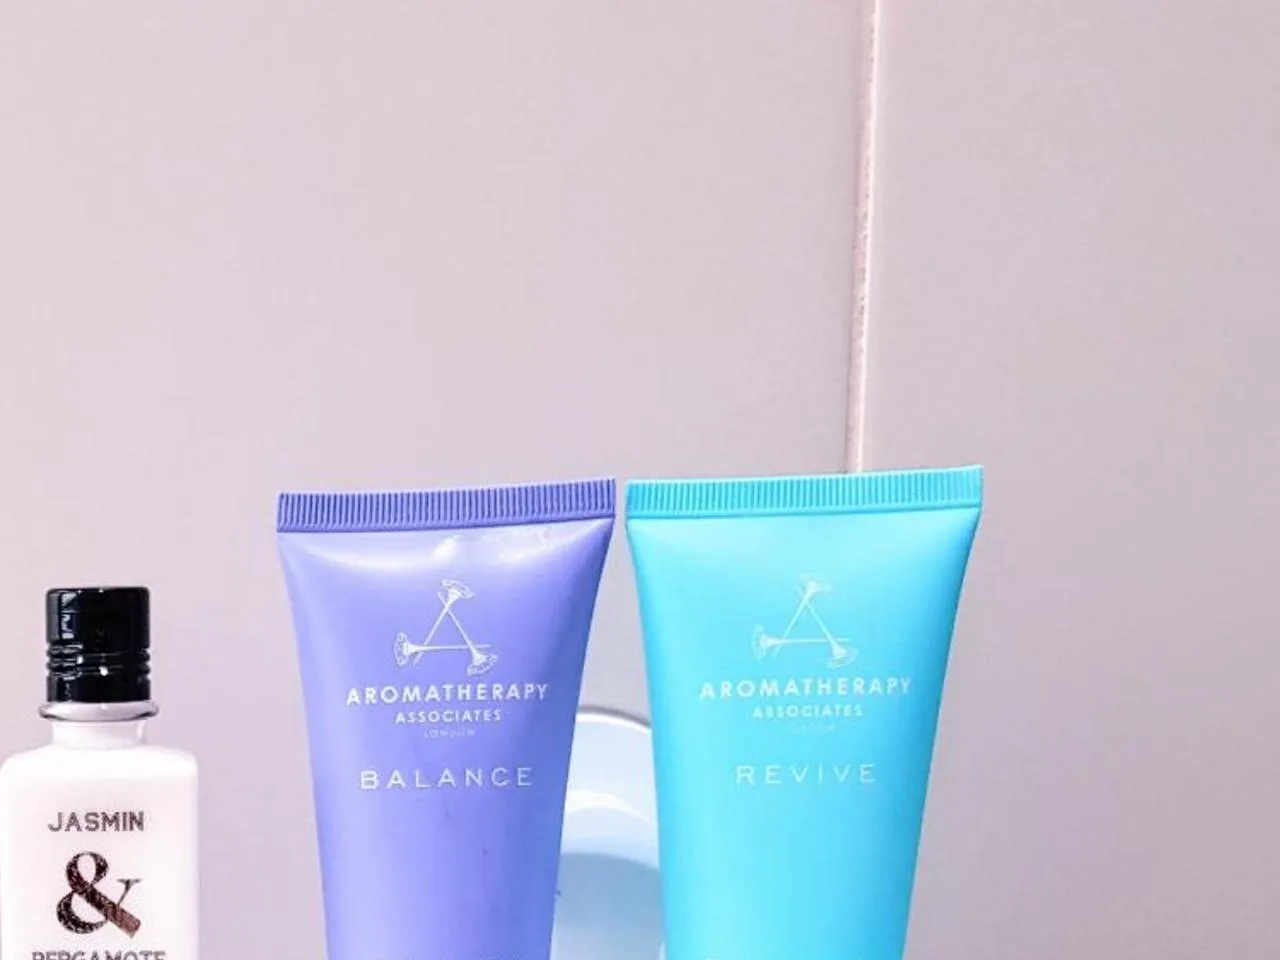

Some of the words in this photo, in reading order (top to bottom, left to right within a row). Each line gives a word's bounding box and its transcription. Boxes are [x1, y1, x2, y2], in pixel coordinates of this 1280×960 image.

[346, 682, 550, 706] AROMATHERAPY
[699, 676, 914, 701] AROMATHERAPY
[394, 708, 502, 725] ASSOCIATES
[752, 703, 863, 720] ASSOCIATES
[360, 766, 534, 791] BALANCE
[735, 763, 877, 786] REVIVE
[48, 811, 145, 833] JASMIN
